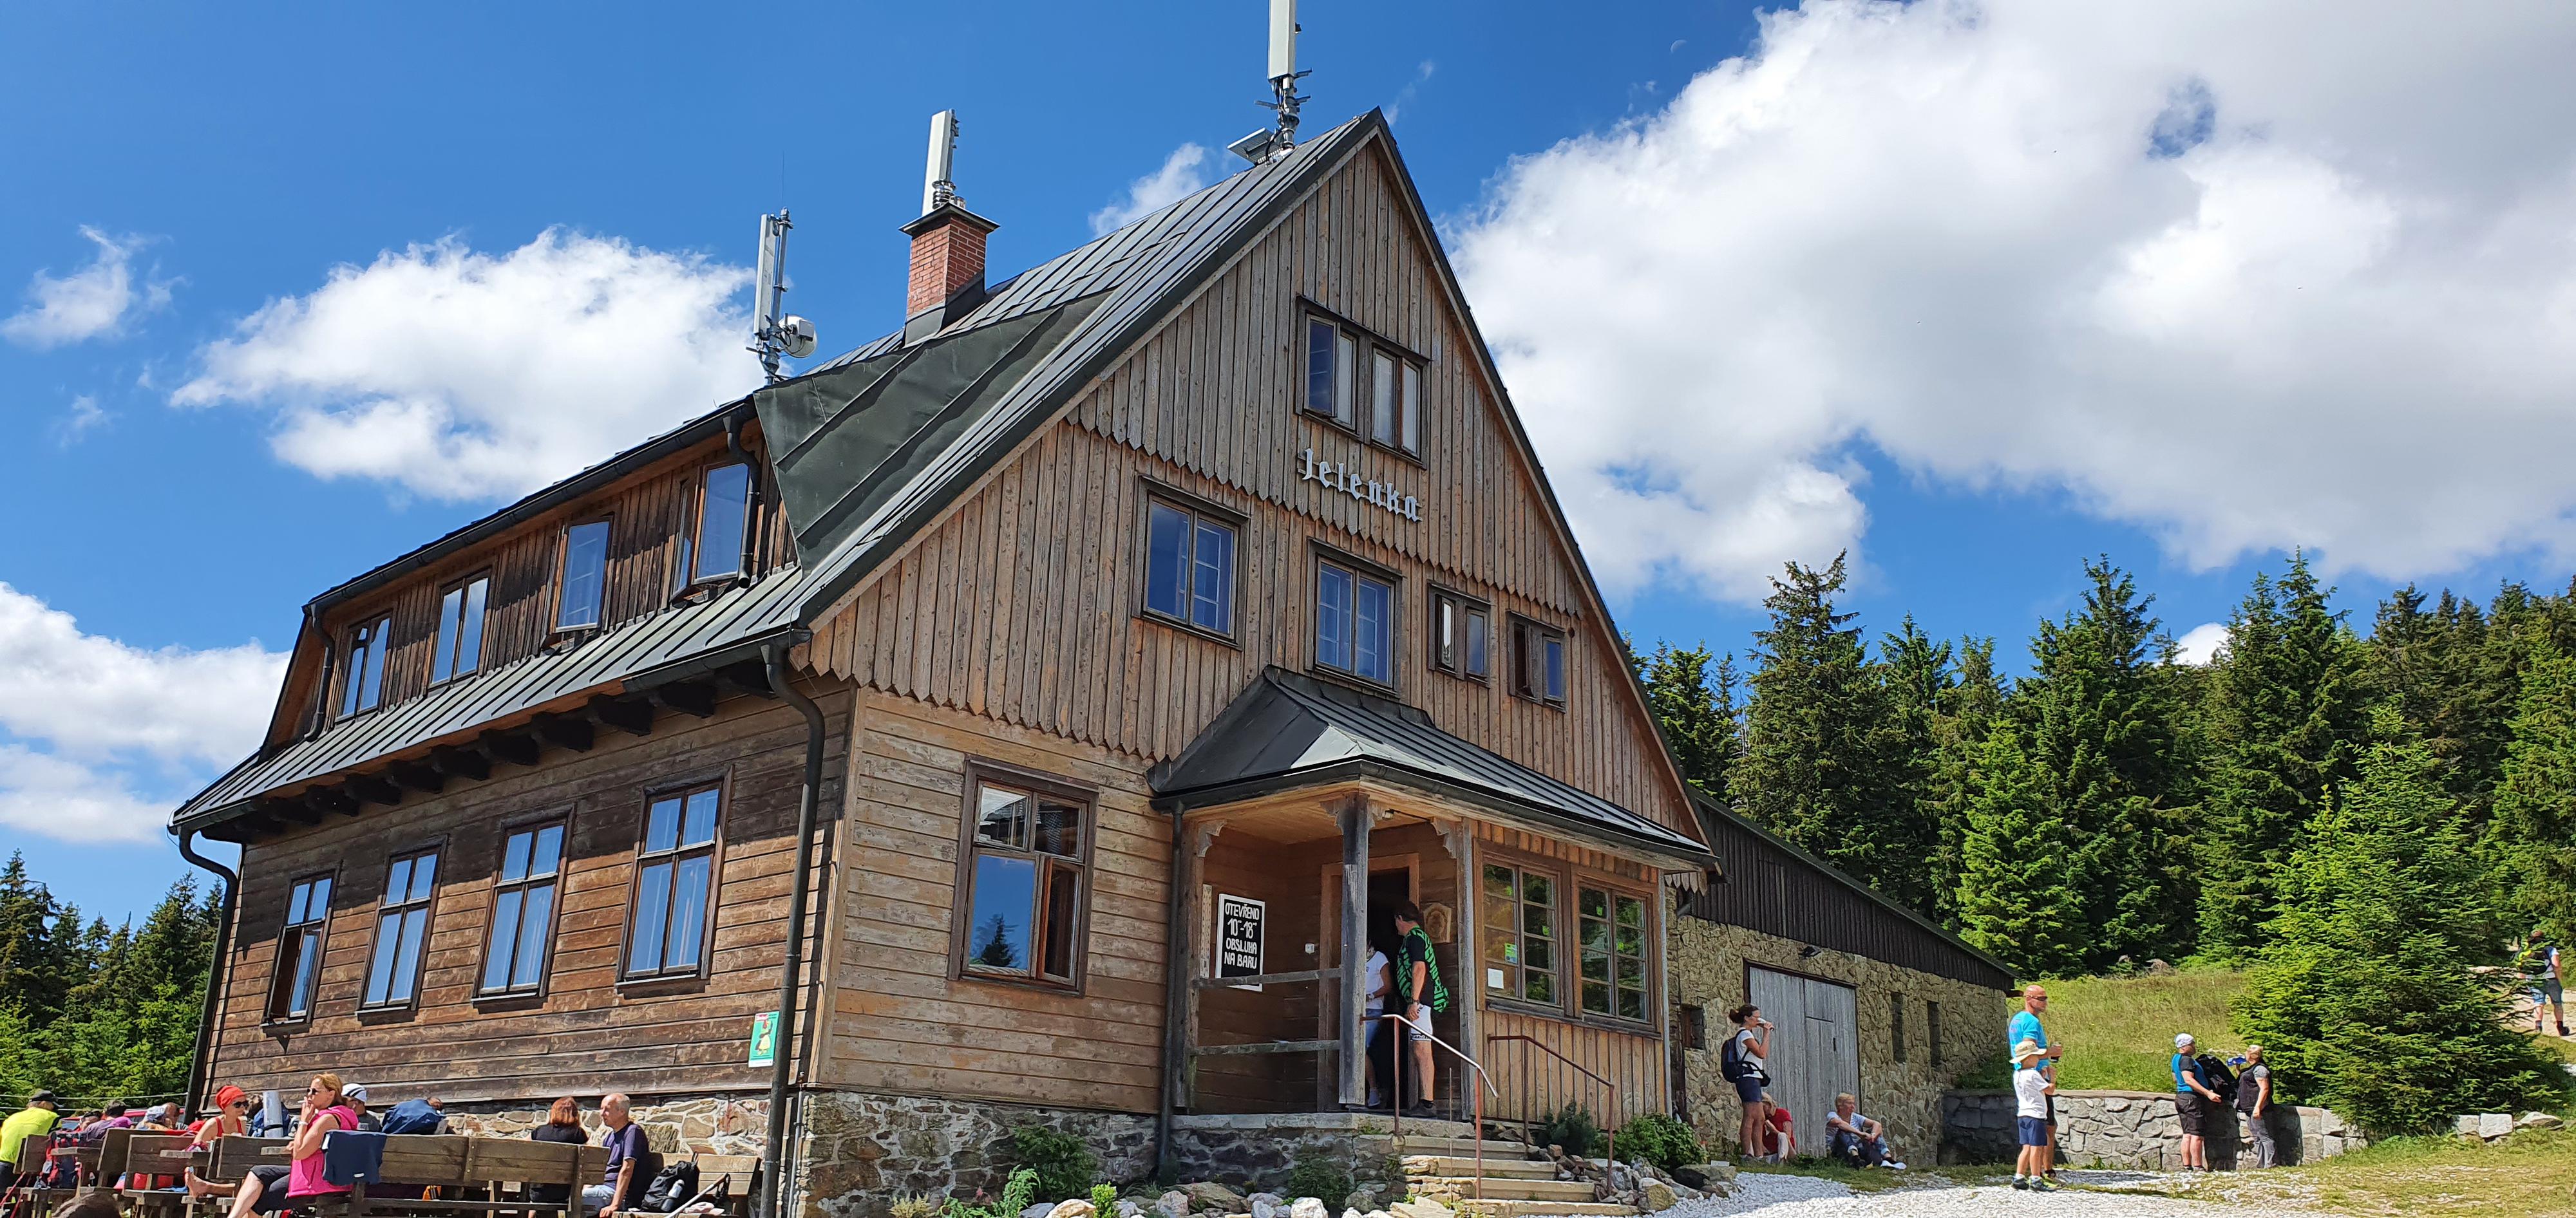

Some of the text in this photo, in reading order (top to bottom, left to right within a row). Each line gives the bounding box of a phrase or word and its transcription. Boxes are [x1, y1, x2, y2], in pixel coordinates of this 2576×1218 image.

[1302, 448, 1417, 522] Jelenka
[1225, 902, 1260, 921] OTEVŘENO
[1226, 937, 1257, 954] OBSLUHA
[1224, 951, 1257, 970] NA BARU
